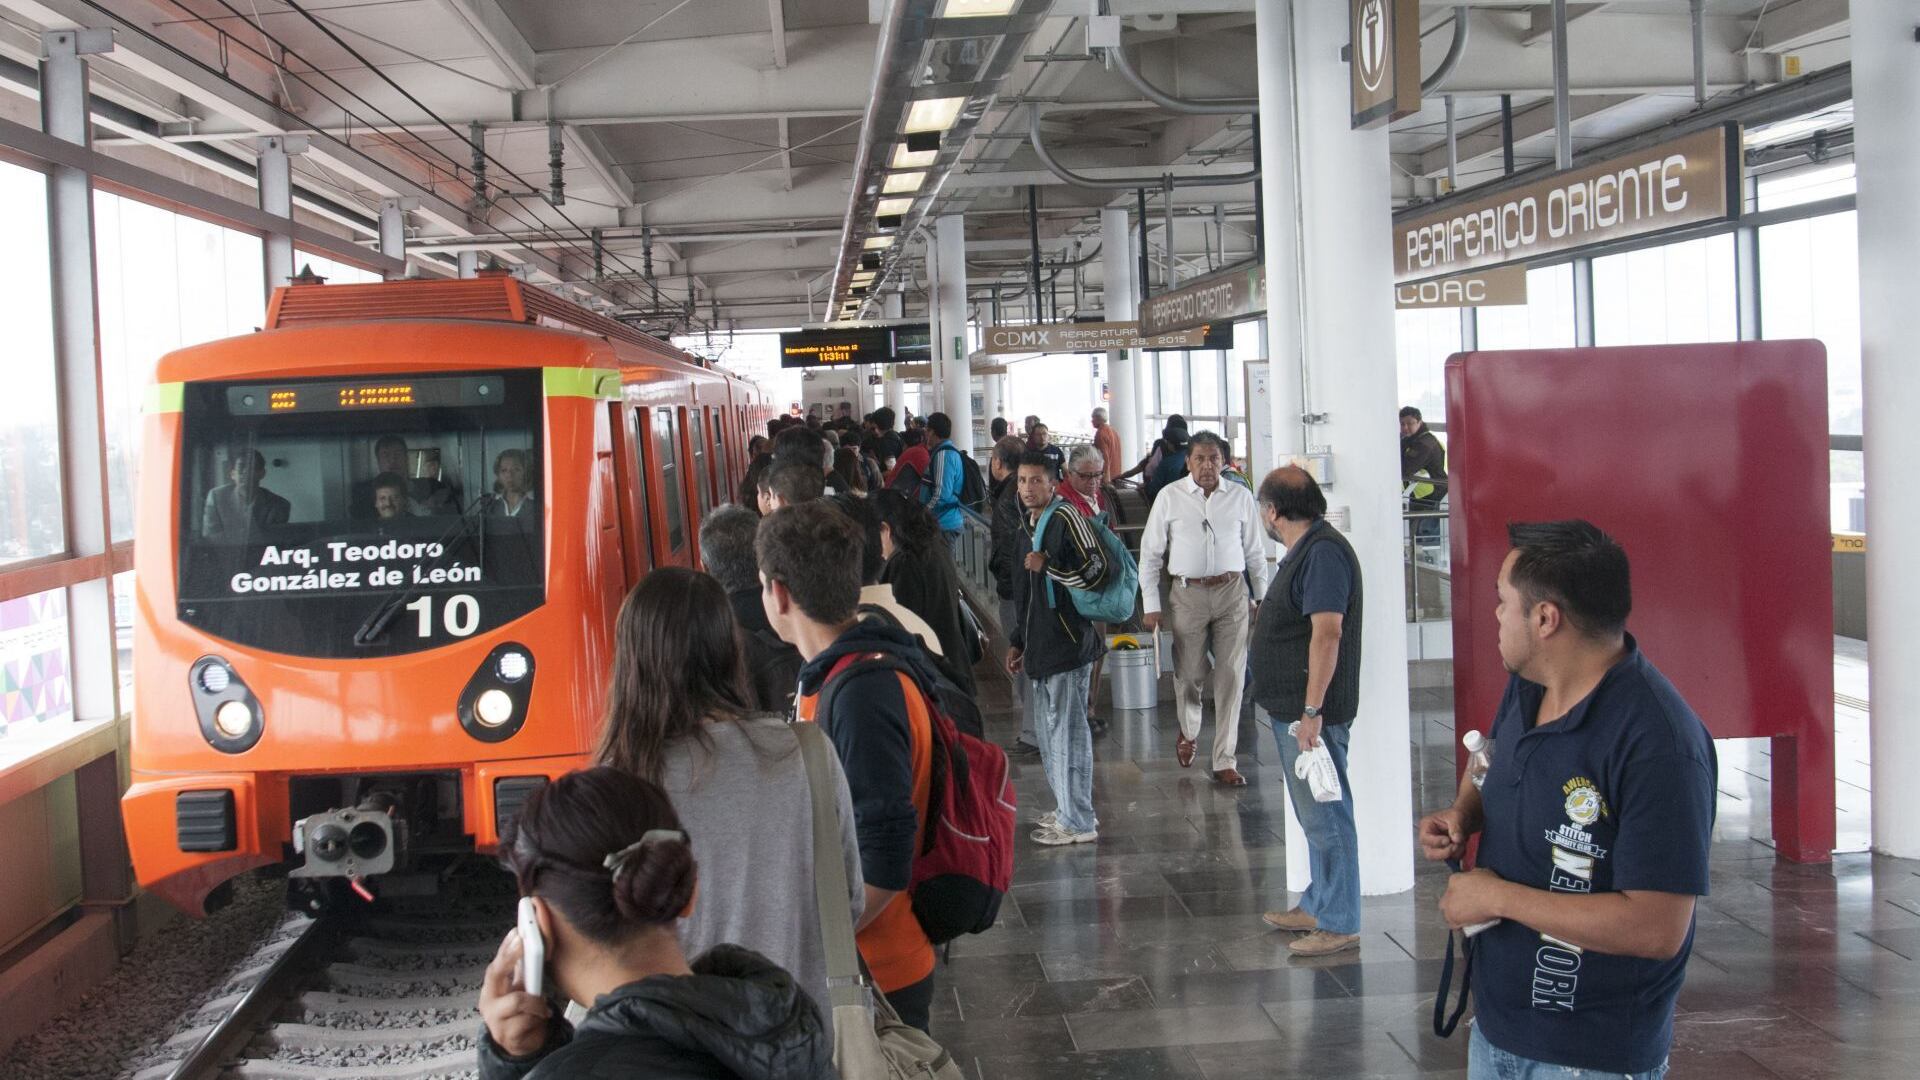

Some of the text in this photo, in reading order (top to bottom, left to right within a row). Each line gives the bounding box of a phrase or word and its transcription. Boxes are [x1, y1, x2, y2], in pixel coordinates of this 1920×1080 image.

[1407, 154, 1688, 271] PERIFERICO ORIENTE
[1153, 294, 1193, 326] PERIFERICO
[1196, 283, 1233, 316] ORIENTE
[1397, 280, 1486, 304] COAC
[994, 330, 1050, 347] CDMX
[1060, 328, 1138, 339] REAPERTURA
[1066, 338, 1124, 349] OCTUBRE
[1158, 335, 1187, 345] 2015
[819, 352, 849, 361] 11:31:11
[260, 540, 444, 570] Arq. Teodoro
[231, 562, 482, 594] González de León
[406, 594, 481, 639] 10
[1559, 824, 1593, 843] STITCH
[1551, 846, 1594, 894] NE
